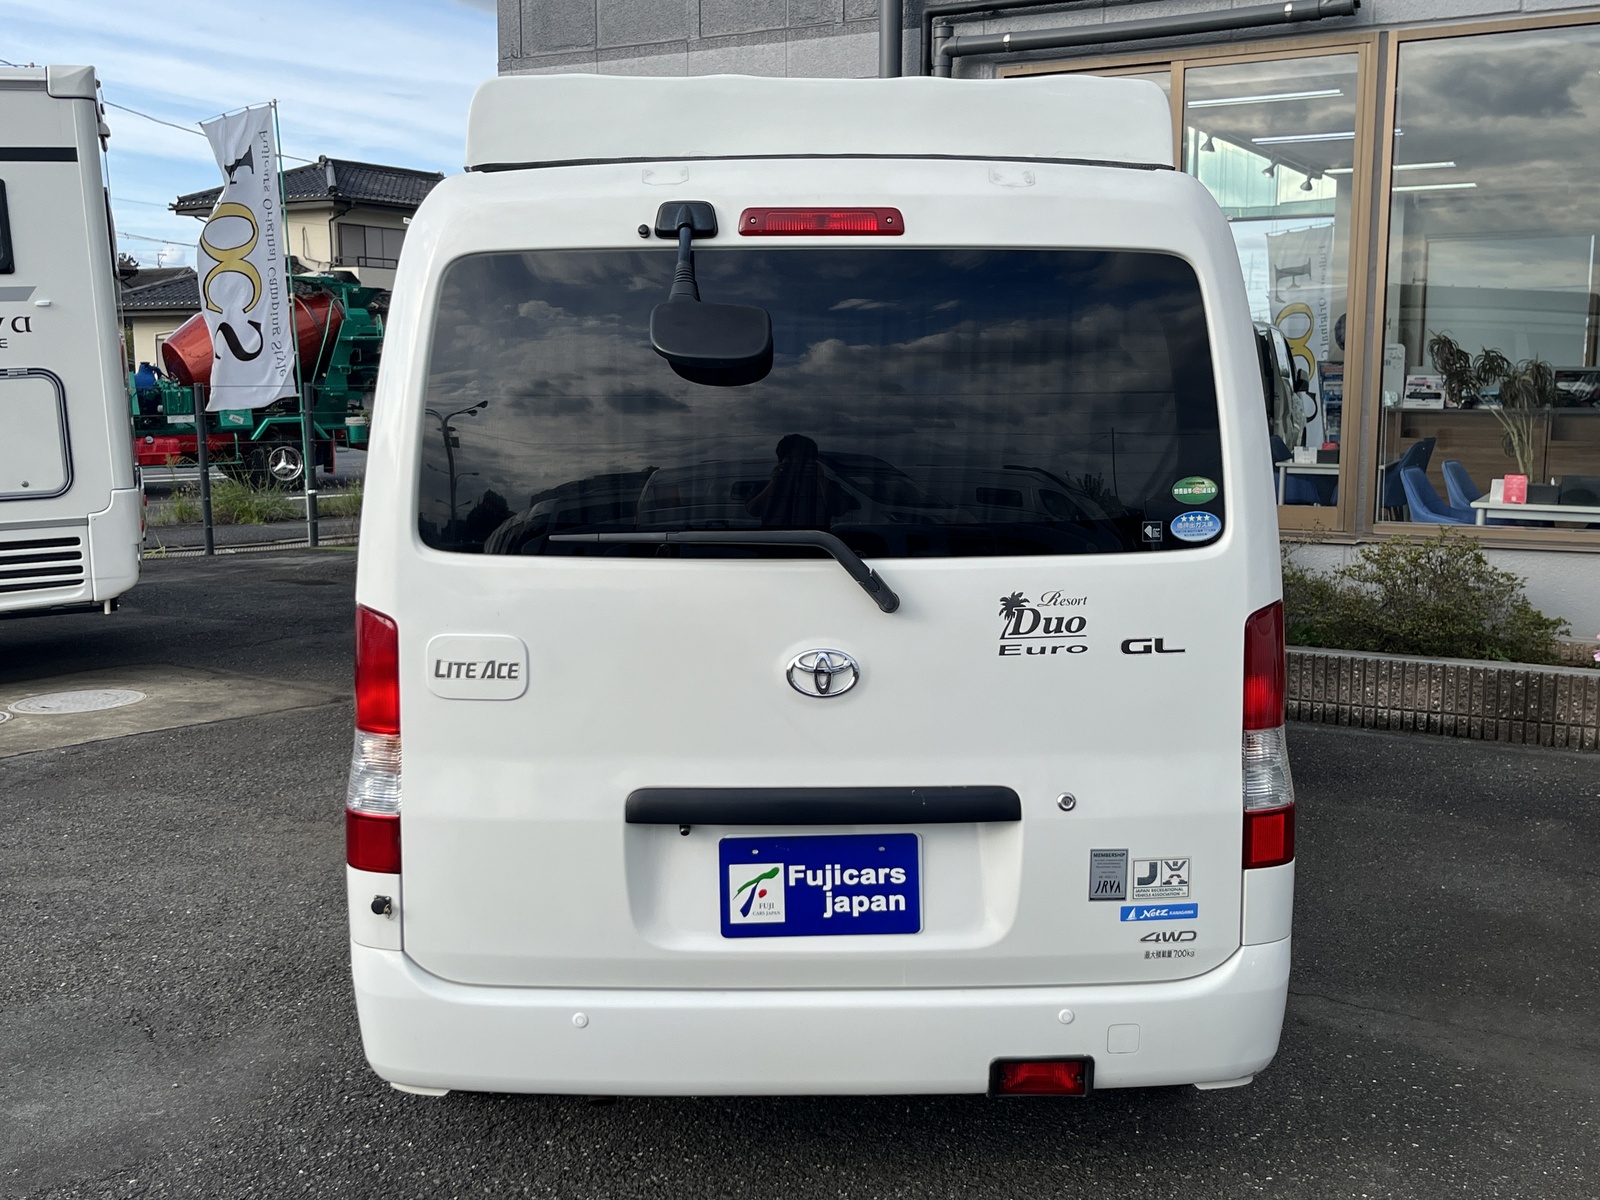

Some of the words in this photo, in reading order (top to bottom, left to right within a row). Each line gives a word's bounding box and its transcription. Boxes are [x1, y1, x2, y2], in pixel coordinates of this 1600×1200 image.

[1037, 590, 1088, 607] Resort
[1008, 607, 1087, 636] Duo
[999, 643, 1089, 656] Euro
[1121, 637, 1186, 655] GL
[435, 659, 477, 678] LITE
[481, 660, 519, 679] ACE
[788, 864, 907, 891] Fujicars
[759, 902, 775, 910] FUJI
[823, 891, 907, 918] japan
[1140, 908, 1169, 919] Netz
[1140, 930, 1197, 943] 4WD
